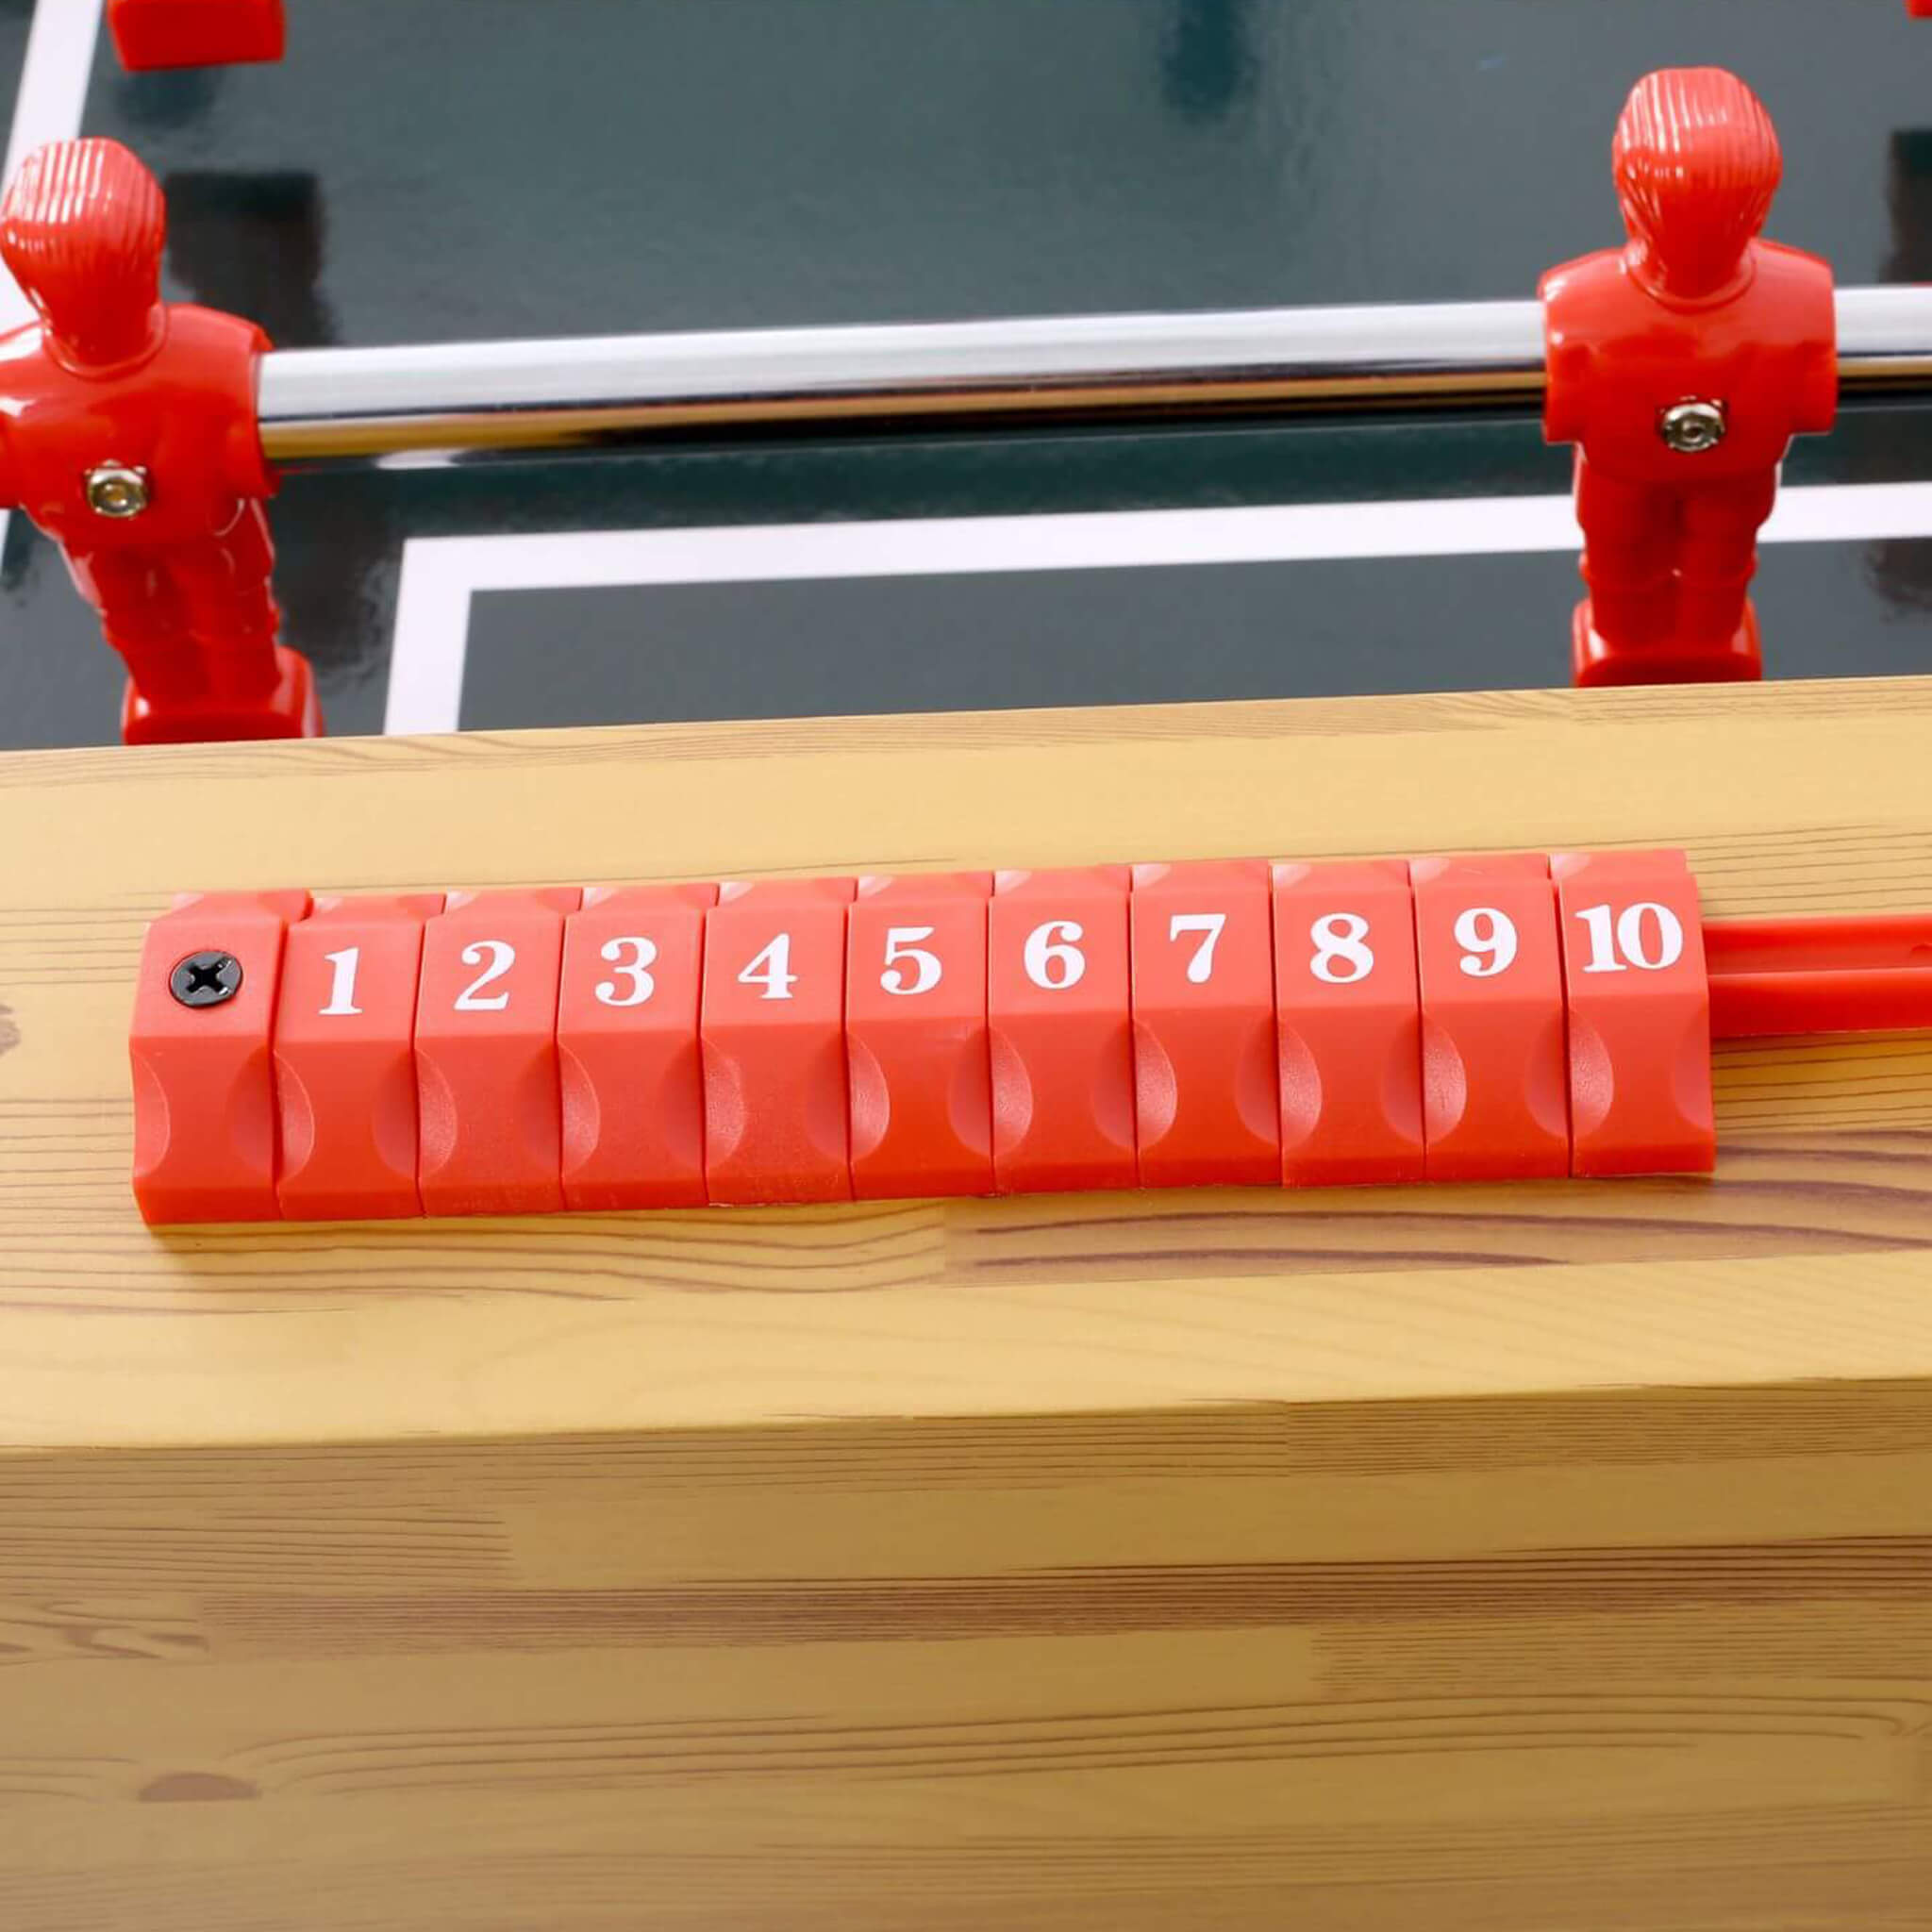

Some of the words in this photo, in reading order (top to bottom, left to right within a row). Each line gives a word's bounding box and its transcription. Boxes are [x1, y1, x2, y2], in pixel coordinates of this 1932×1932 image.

[319, 946, 363, 1015] 1
[453, 940, 516, 1011] 2
[594, 936, 658, 1007] 3
[737, 932, 798, 1000] 4
[880, 925, 942, 995] 5
[1024, 920, 1086, 990] 6
[1169, 913, 1226, 983] 7
[1309, 912, 1374, 983] 8
[1454, 907, 1518, 977] 9
[1574, 902, 1684, 973] 10
